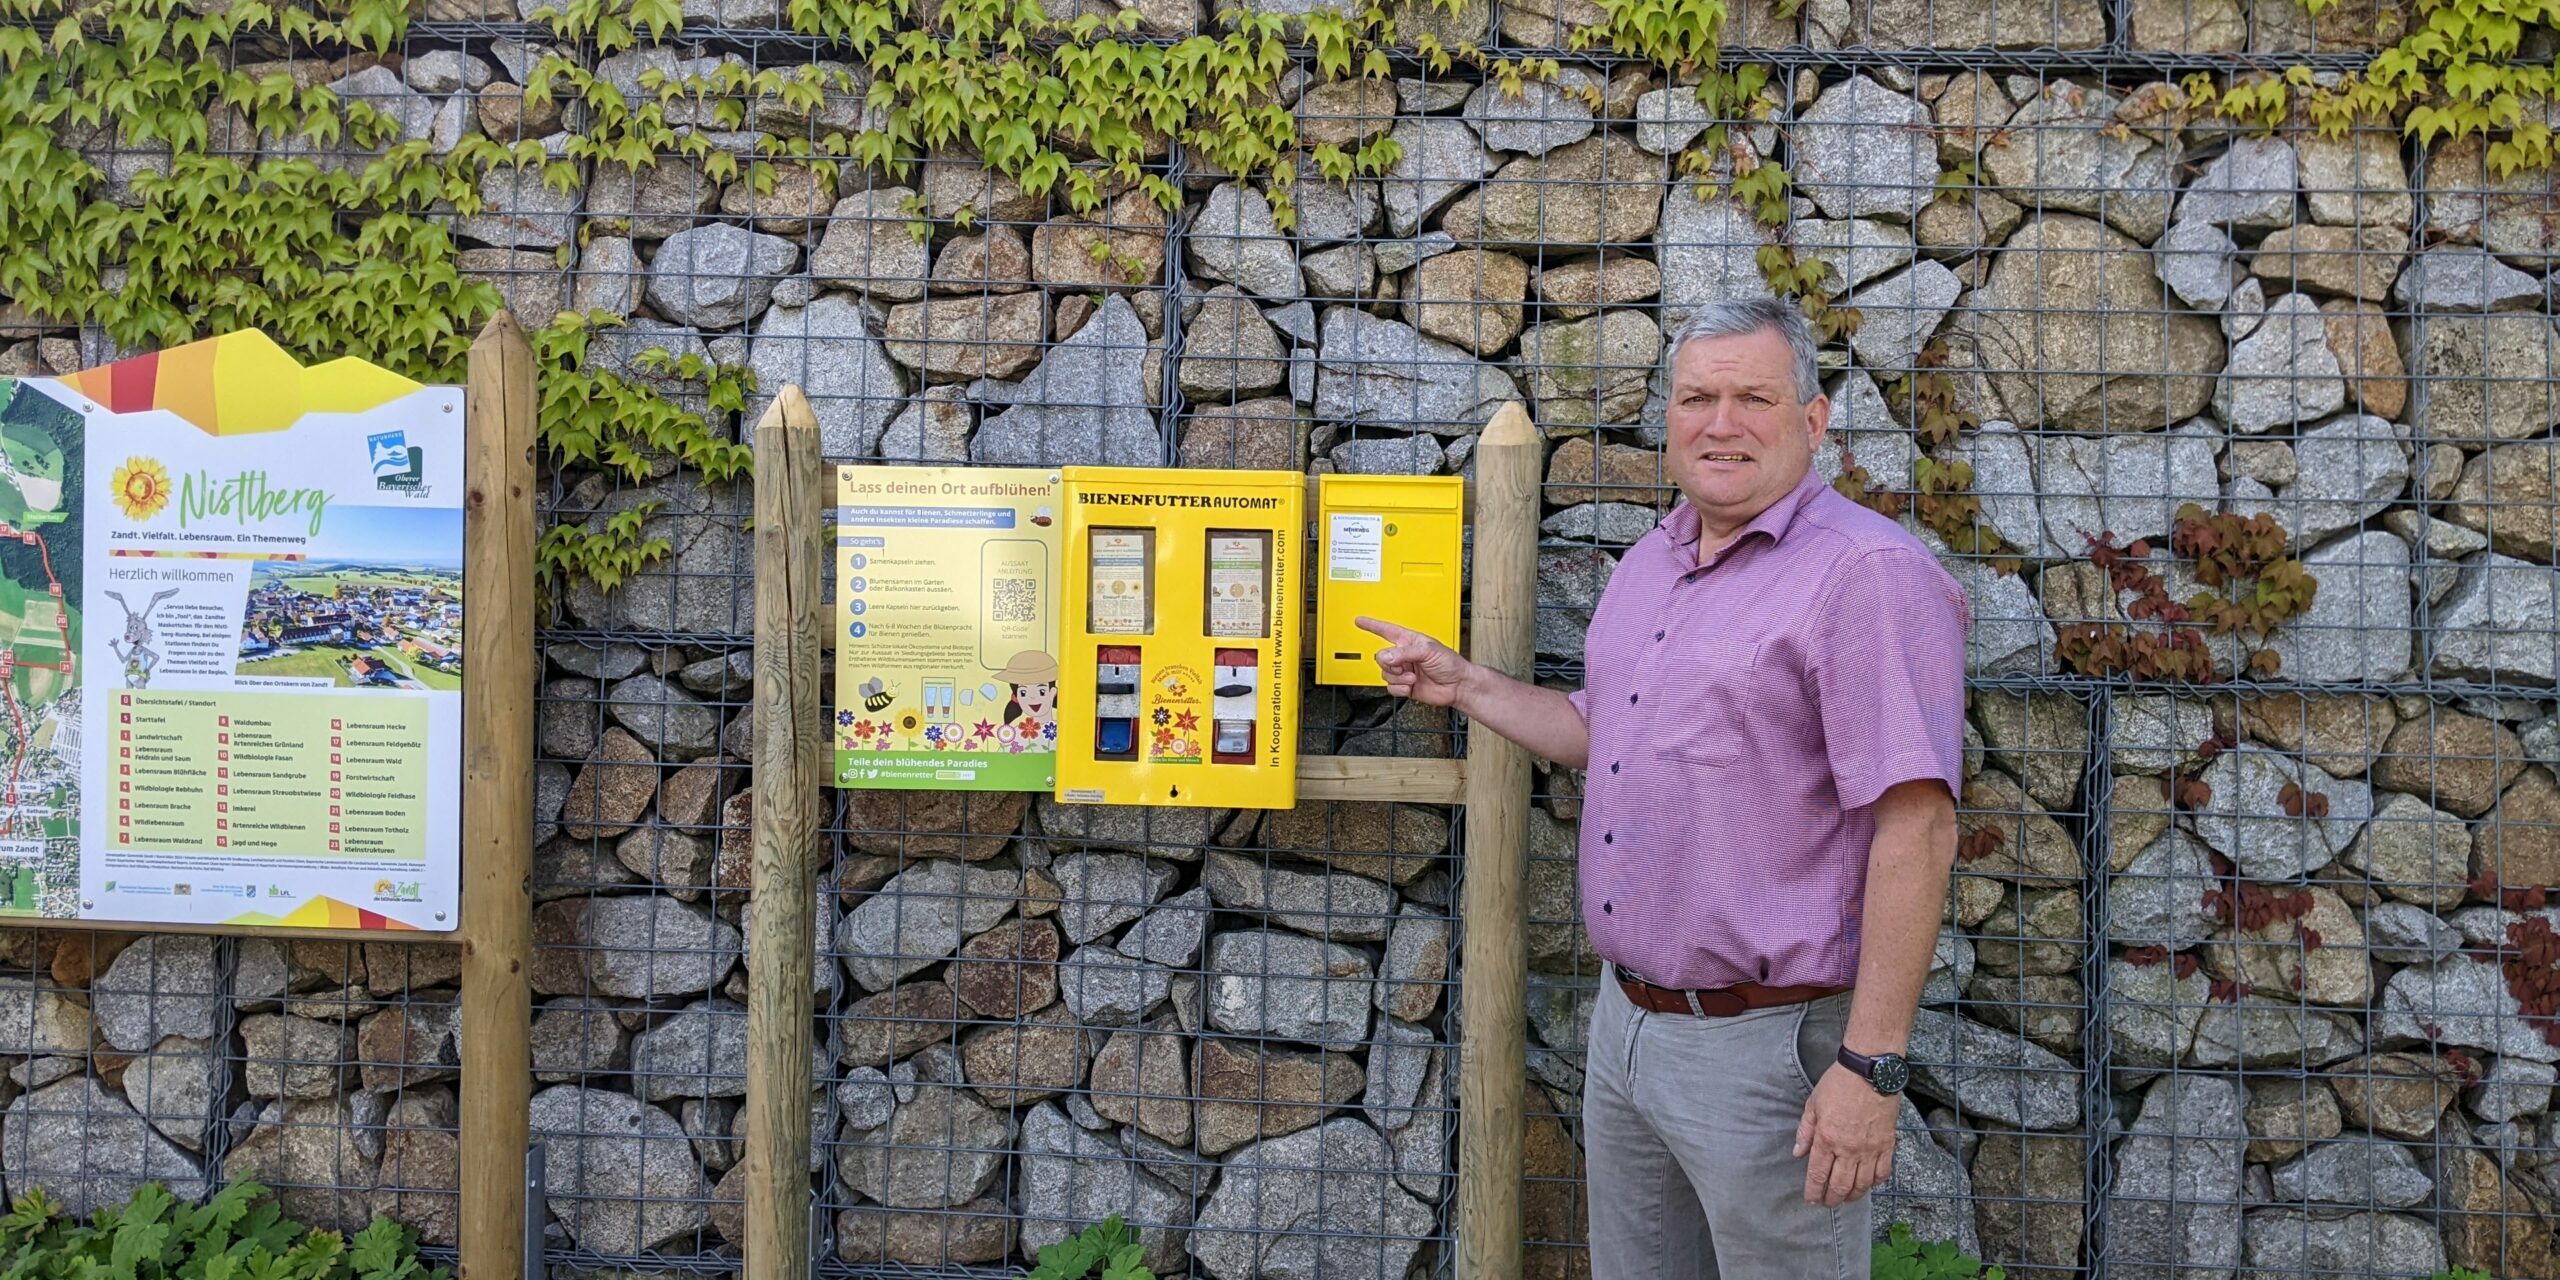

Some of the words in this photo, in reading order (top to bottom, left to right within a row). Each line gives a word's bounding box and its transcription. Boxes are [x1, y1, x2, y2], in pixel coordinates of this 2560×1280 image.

[369, 432, 402, 442] NATURPARK
[395, 474, 420, 482] Oberer
[379, 482, 432, 492] Bayerischer
[850, 481, 882, 494] Lass
[886, 481, 937, 494] deinen
[941, 482, 967, 495] Ort
[970, 483, 1051, 496] aufblühen!
[405, 490, 430, 498] Wald
[944, 510, 996, 518] Schmetterlinge
[111, 531, 141, 542] Zandt.
[142, 531, 177, 542] Vielfalt.
[178, 532, 235, 543] Lebensraum.
[237, 533, 251, 543] Ein
[252, 534, 306, 545] Themenweg
[870, 558, 914, 566] Samenkapseln
[109, 567, 158, 583] Herzlich
[161, 568, 234, 582] willkommen
[855, 580, 862, 589] 2
[1273, 529, 1286, 657] www.bienenretter.com
[855, 603, 861, 612] 3
[854, 625, 861, 634] 4
[1272, 661, 1282, 675] mit
[135, 697, 184, 706] Übersichtstafel
[1270, 676, 1281, 754] Kooperation
[233, 753, 274, 761] Wildbiologie
[1270, 755, 1279, 768] In
[848, 757, 871, 766] Teile
[872, 758, 894, 767] dein
[895, 759, 945, 768] blühendes
[947, 759, 988, 768] Paradies
[345, 774, 395, 782] Forstwirtschaft
[880, 770, 934, 779] #bienenretter
[134, 785, 175, 793] Wildbiologie
[272, 789, 322, 797] Streuobstwiese
[232, 822, 269, 830] Artenreiche
[15, 845, 39, 853] Zandt
[344, 846, 395, 854] Kleinstrukturen
[394, 880, 427, 898] Zandt
